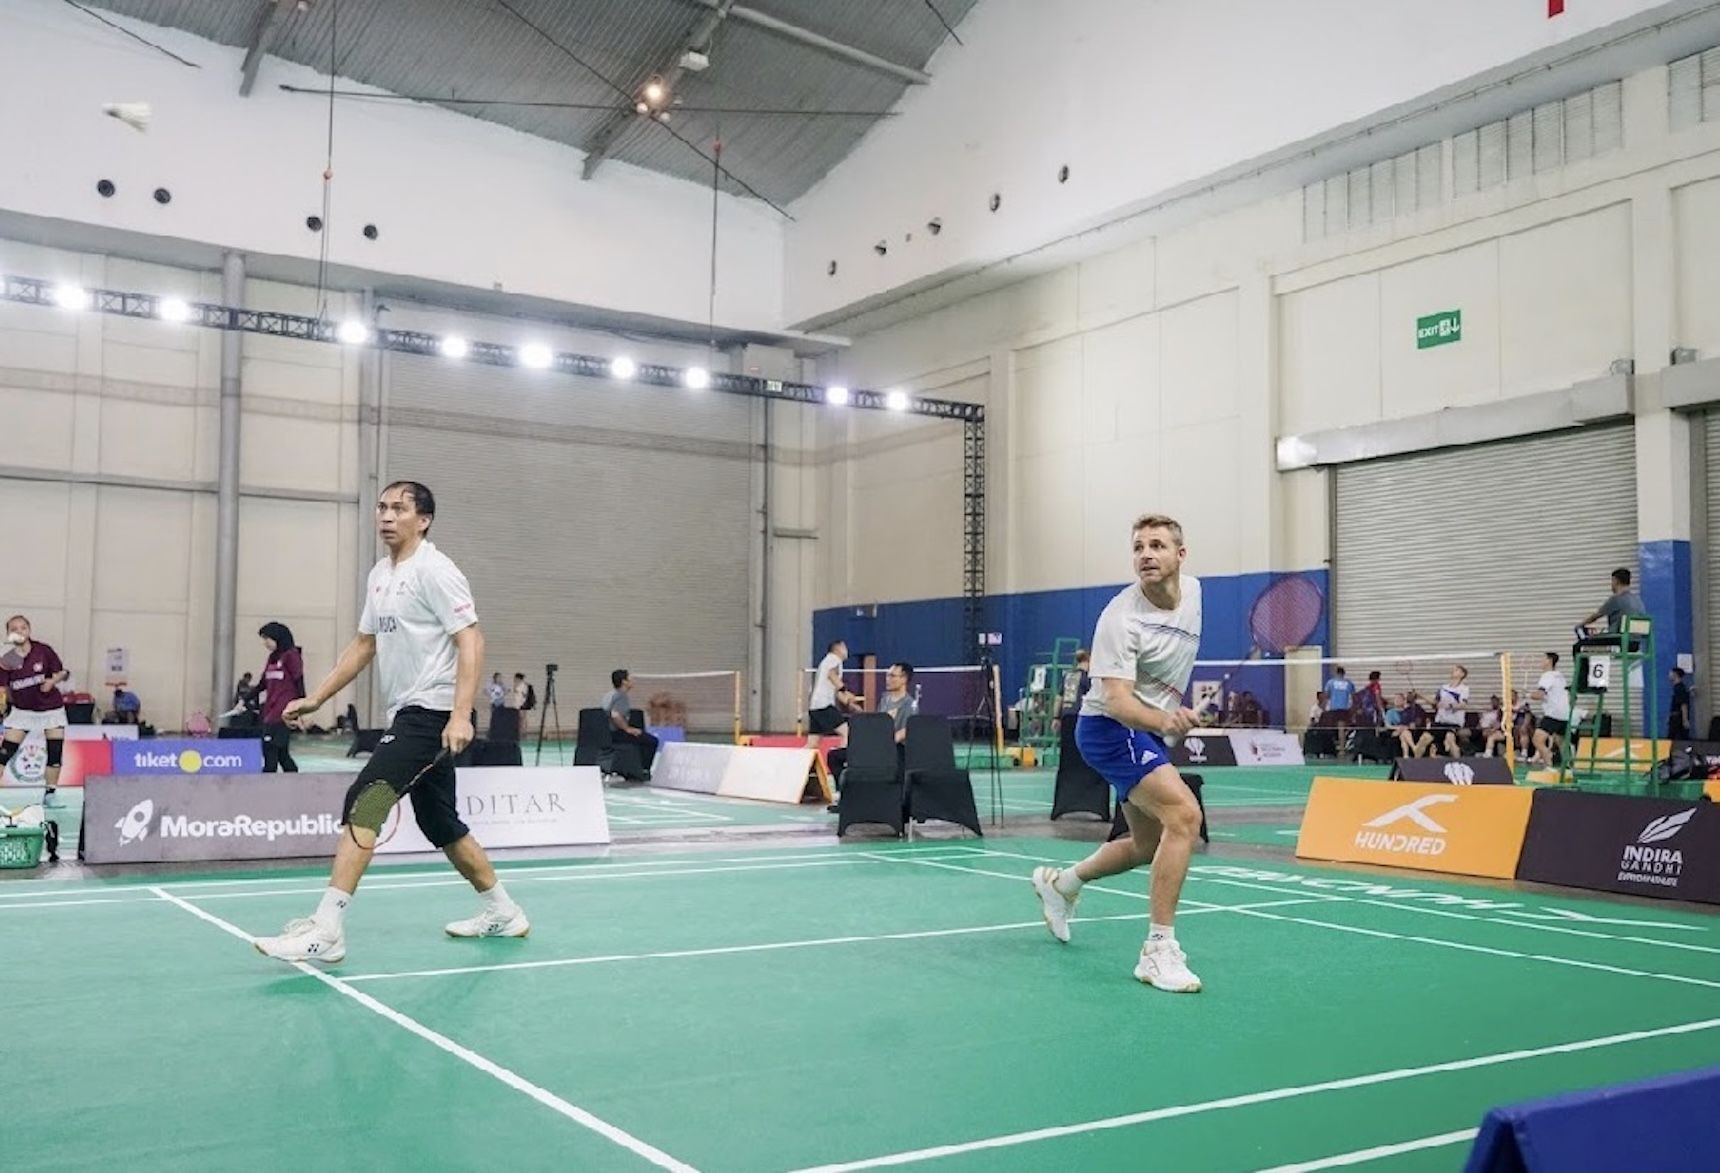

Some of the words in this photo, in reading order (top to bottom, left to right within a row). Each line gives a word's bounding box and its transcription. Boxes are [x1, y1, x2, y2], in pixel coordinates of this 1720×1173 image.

[1418, 325, 1439, 338] EXIT
[1592, 663, 1604, 679] 6
[160, 813, 345, 841] MoraRepublic
[1355, 831, 1447, 856] HUNDRED
[1623, 845, 1683, 864] INDIRA
[1620, 861, 1682, 876] GANDHI
